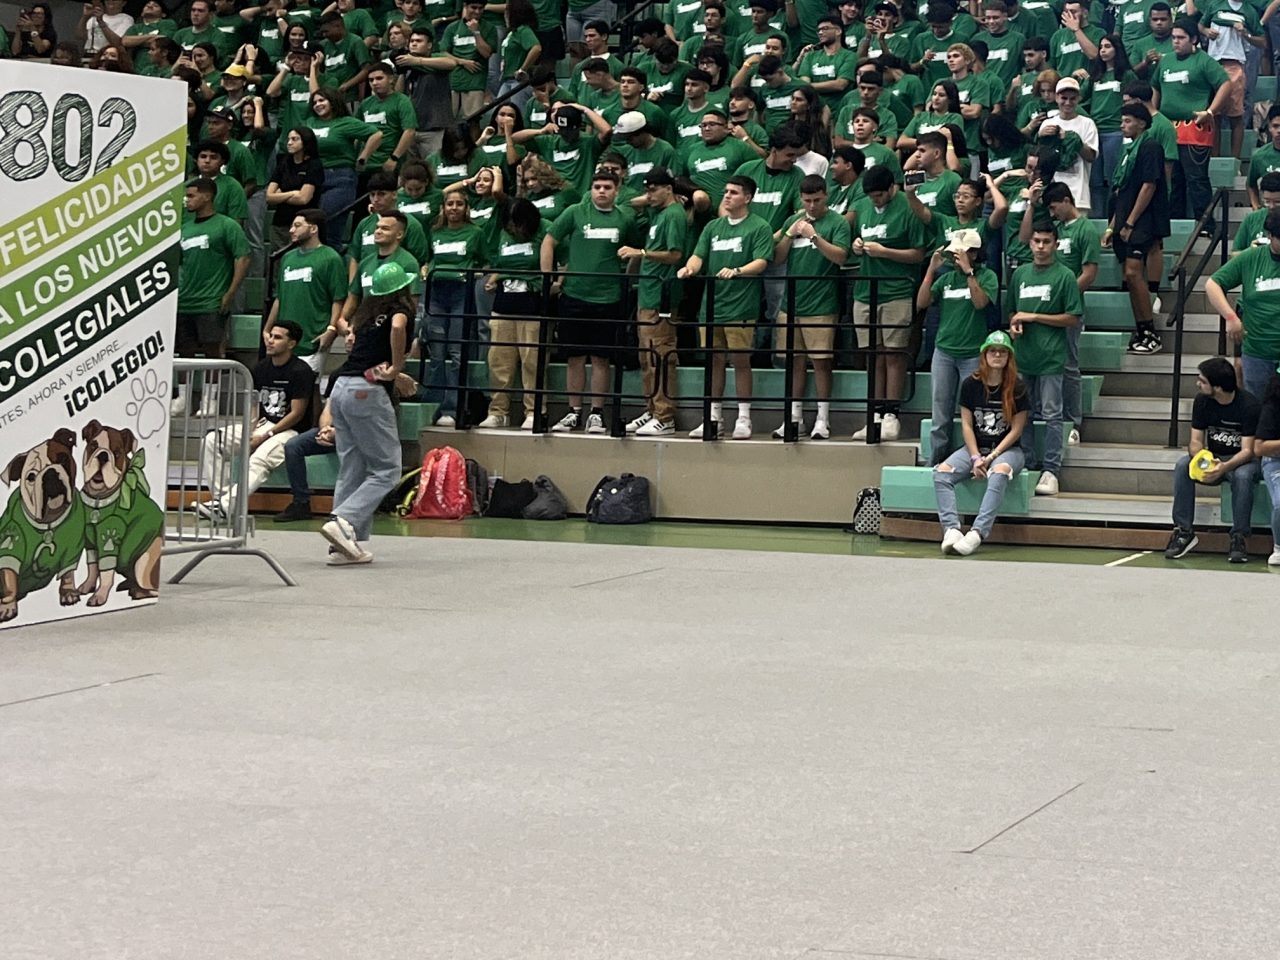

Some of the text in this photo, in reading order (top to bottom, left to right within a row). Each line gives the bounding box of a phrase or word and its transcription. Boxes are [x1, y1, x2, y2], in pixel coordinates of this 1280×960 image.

[0, 90, 137, 182] 802
[0, 143, 181, 266] FELICIDADES
[15, 264, 74, 317] LOS
[78, 200, 178, 280] NUEVOS
[0, 261, 171, 392] COLEGIALES
[63, 330, 165, 418] ¡COLEGIO!
[28, 377, 67, 410] AHORA
[66, 370, 74, 382] Y
